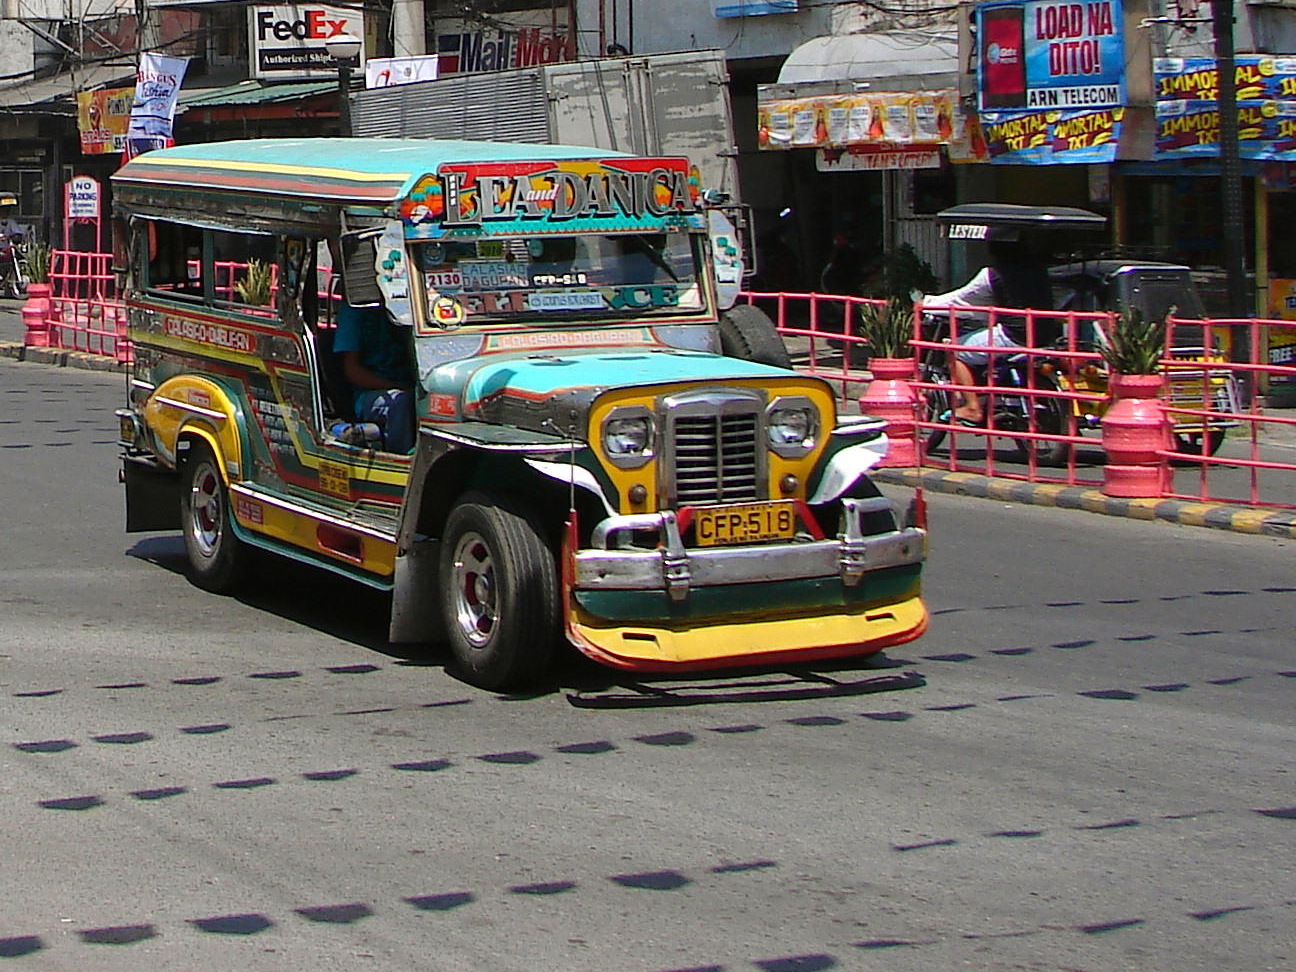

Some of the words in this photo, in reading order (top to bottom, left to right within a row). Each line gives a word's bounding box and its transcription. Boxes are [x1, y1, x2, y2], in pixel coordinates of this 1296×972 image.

[257, 9, 348, 41] FedEx
[1036, 4, 1084, 41] LOAD
[1087, 1, 1113, 37] NA
[263, 53, 308, 65] Authorized
[460, 28, 511, 72] Mail
[516, 28, 571, 68] Mor
[1049, 39, 1101, 77] DITO!
[1028, 89, 1059, 107] ARN
[1062, 87, 1119, 105] TELECOM
[75, 182, 92, 190] NO
[69, 192, 97, 201] PARKING
[439, 170, 543, 229] LEA
[526, 183, 560, 203] and
[547, 167, 698, 222] DANICA
[948, 223, 989, 240] LESTER
[460, 262, 527, 276] CALASIAO
[428, 274, 461, 287] 2130
[461, 275, 530, 289] DAGUPAN
[700, 514, 742, 539] CFP
[747, 510, 791, 534] 518
